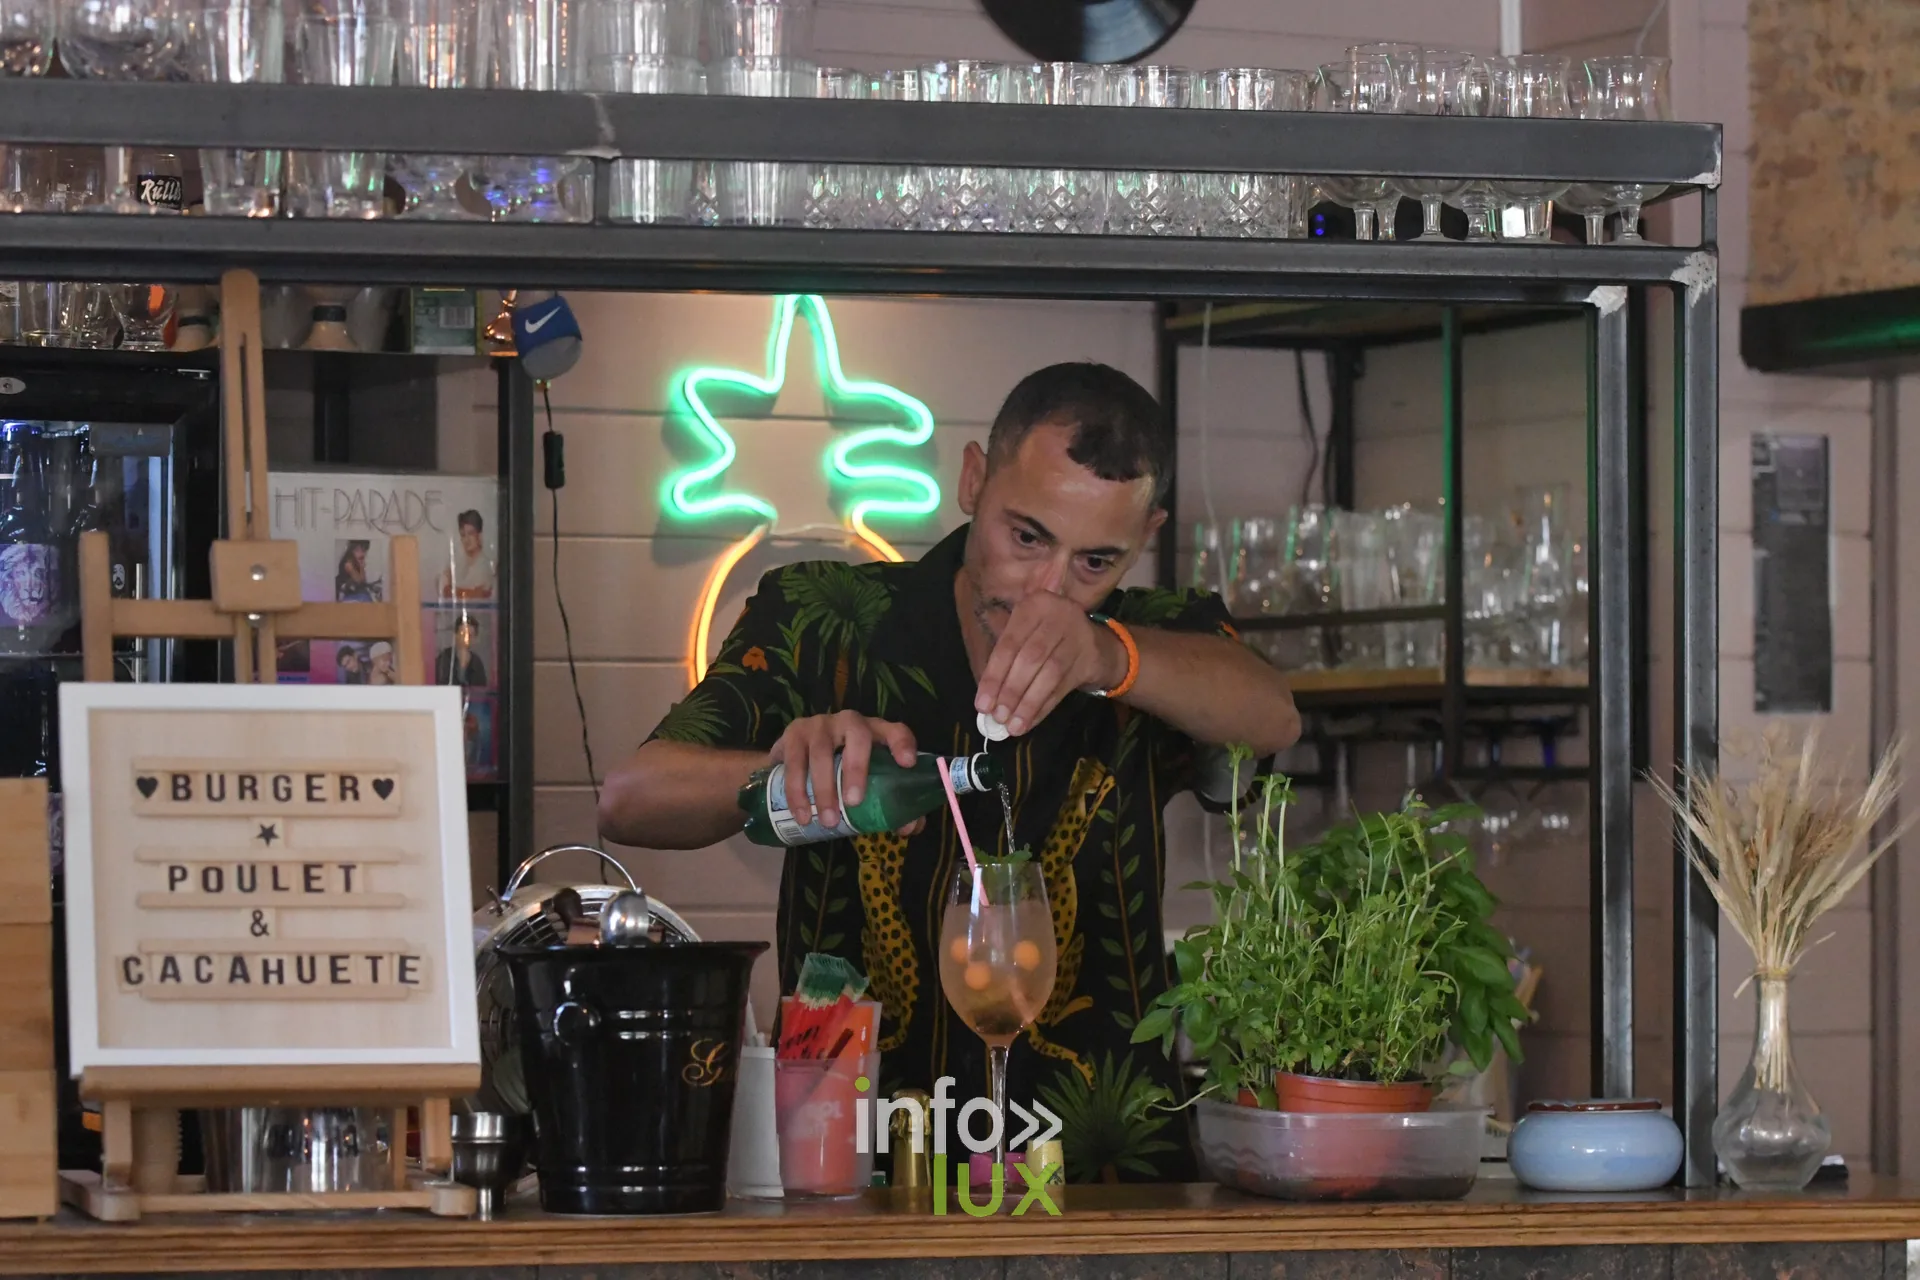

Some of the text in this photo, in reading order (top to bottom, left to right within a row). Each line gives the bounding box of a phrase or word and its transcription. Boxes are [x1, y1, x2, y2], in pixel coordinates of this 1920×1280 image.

[273, 487, 443, 535] HIT-PARADE
[171, 773, 361, 803] BURGER
[168, 863, 358, 894] POULET
[249, 910, 270, 937] &
[122, 954, 422, 986] CACAHUETE
